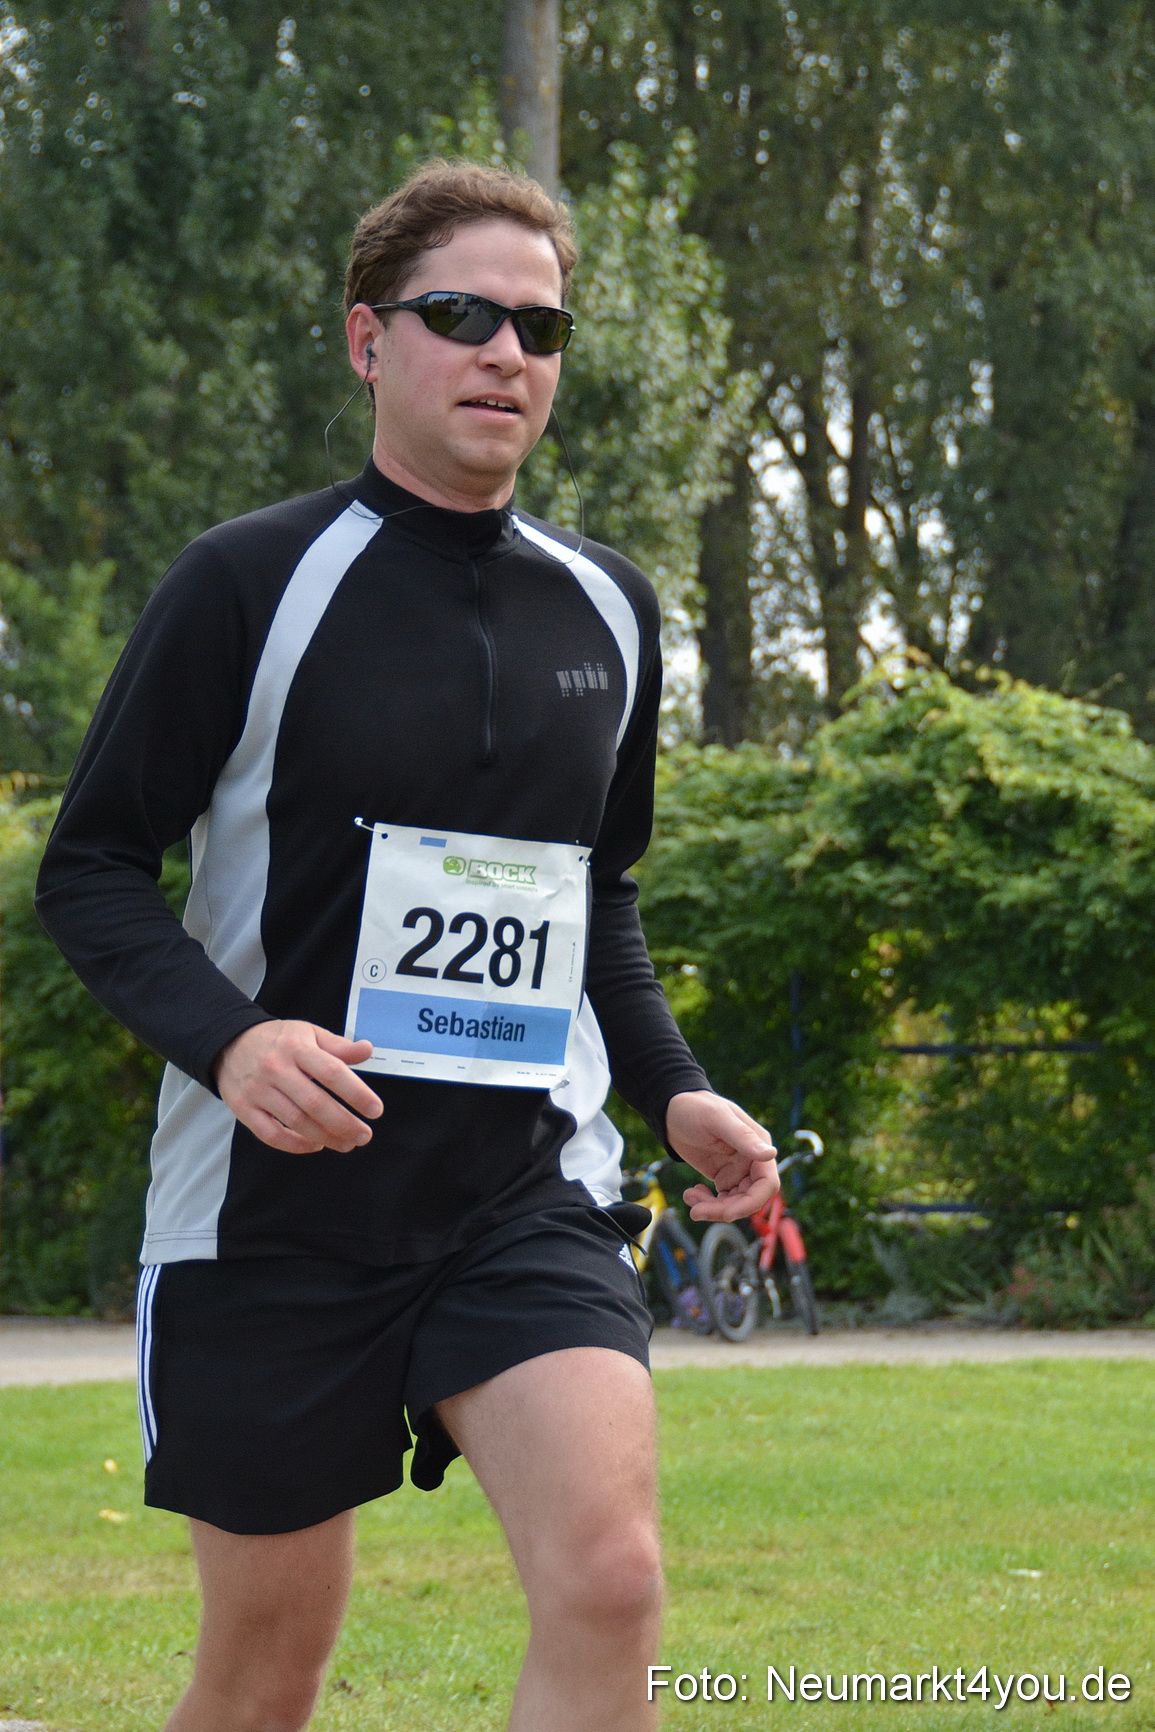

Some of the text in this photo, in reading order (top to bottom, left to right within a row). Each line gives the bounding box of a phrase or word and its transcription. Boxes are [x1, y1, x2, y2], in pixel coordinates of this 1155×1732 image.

[465, 879, 491, 888] inspired
[467, 859, 537, 885] BOCK
[395, 906, 550, 990] 2281
[369, 964, 379, 978] C
[417, 1007, 526, 1042] Sebastian
